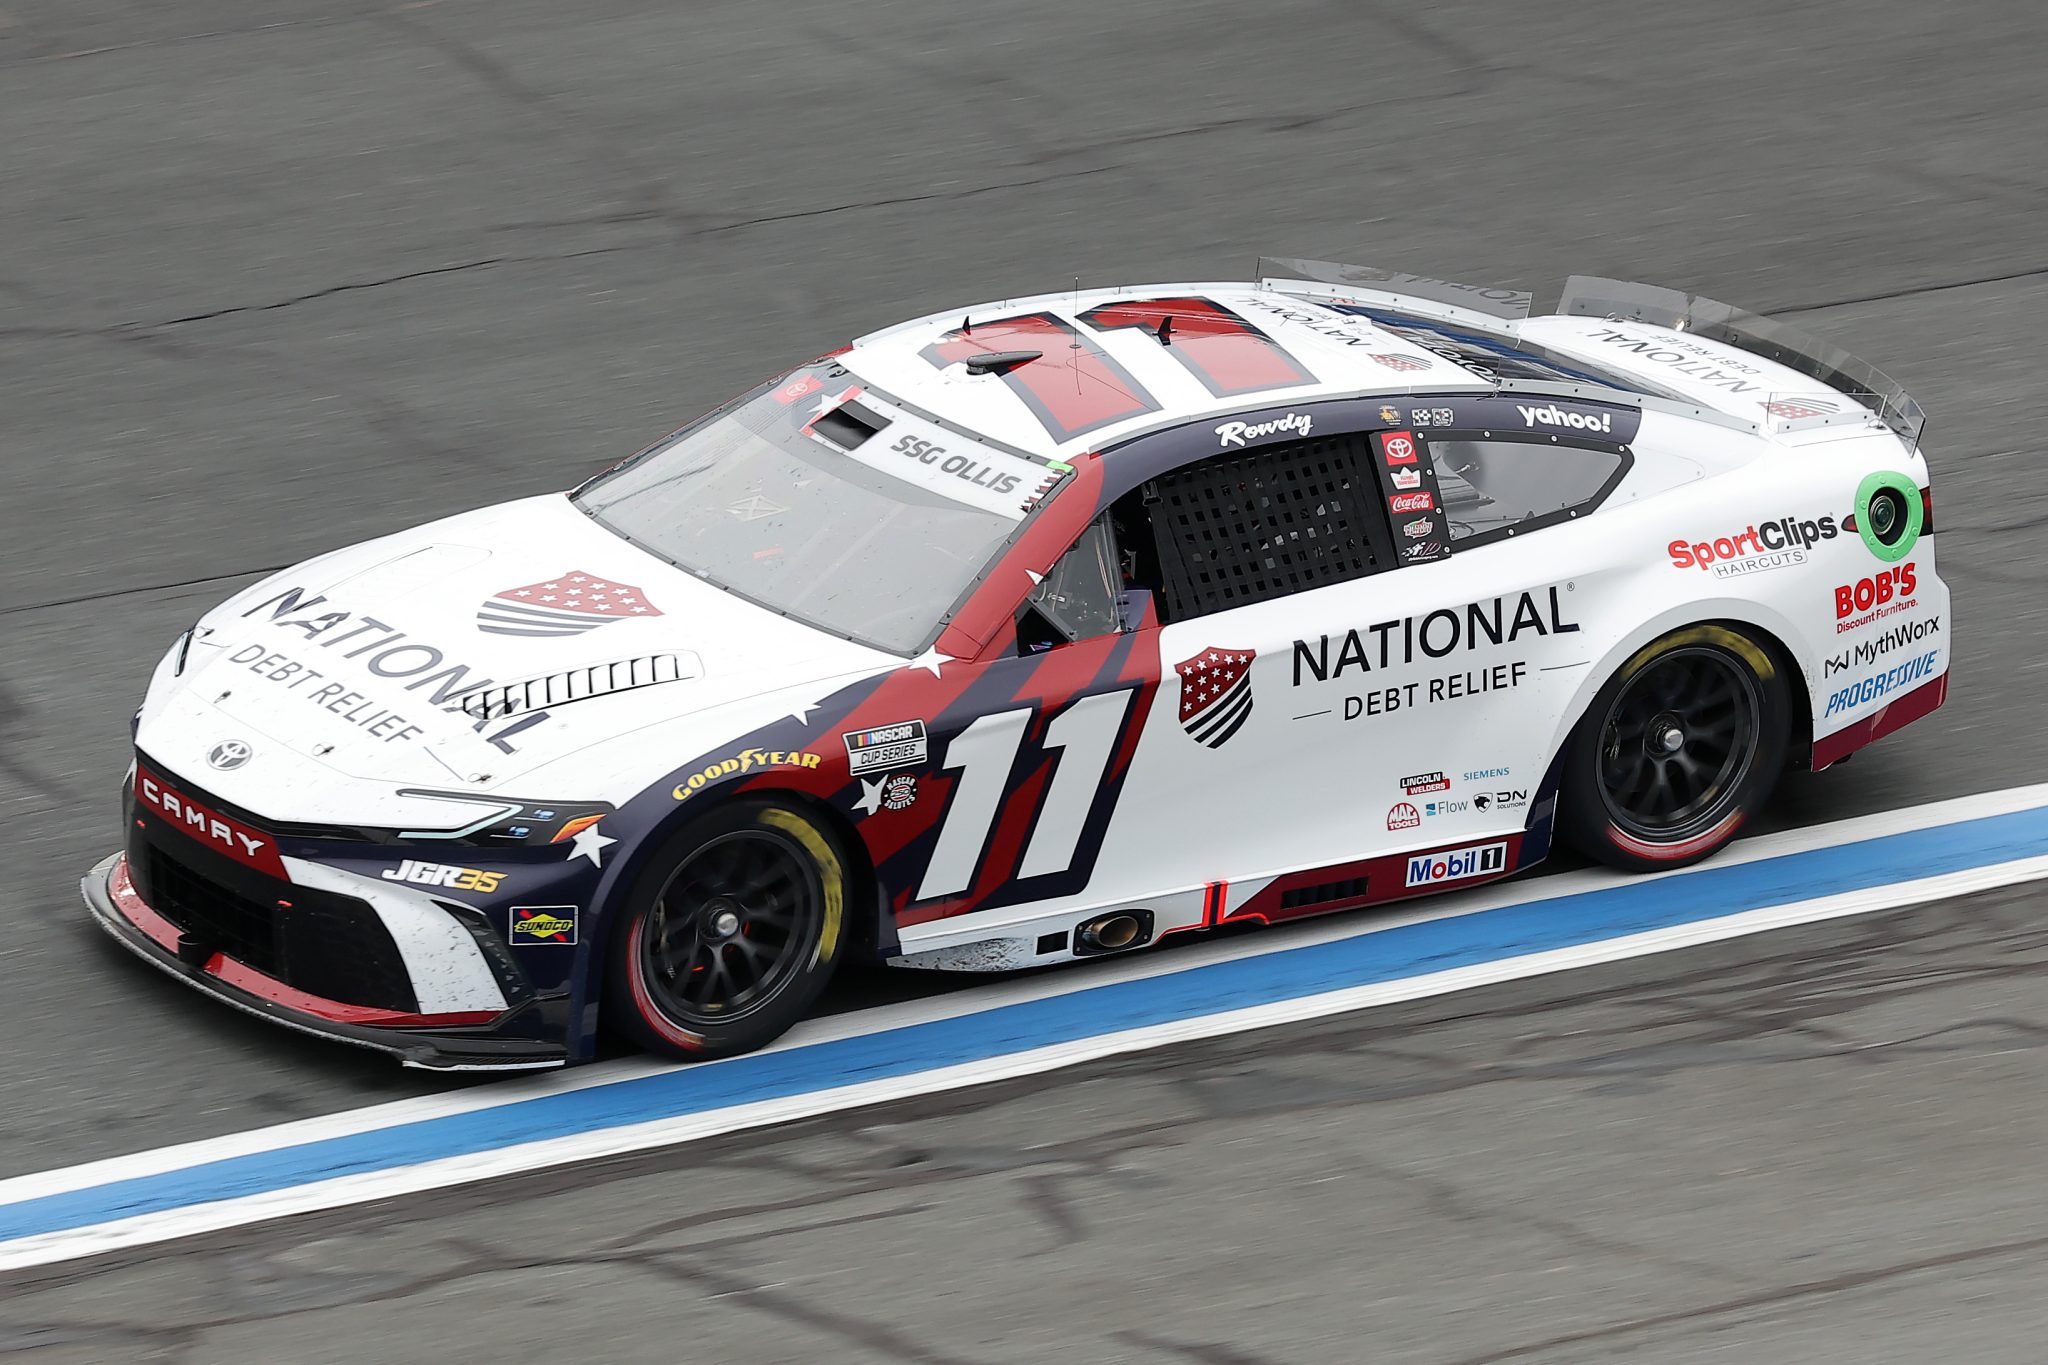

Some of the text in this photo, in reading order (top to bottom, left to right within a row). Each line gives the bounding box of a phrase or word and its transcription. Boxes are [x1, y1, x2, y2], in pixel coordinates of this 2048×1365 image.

[917, 296, 1322, 446] 11
[1587, 328, 1761, 393] NATIONAL
[1648, 334, 1761, 375] DEBT RELIEF
[1214, 412, 1314, 447] Rowdy
[1516, 404, 1611, 433] yahoo!
[890, 434, 1023, 494] SSG OLLIS
[1668, 514, 1838, 571] SportClips
[1716, 550, 1804, 577] HAIRCUTS
[1834, 562, 1917, 620] BOB'S
[1292, 586, 1581, 687] NATIONAL
[1836, 610, 1875, 634] Discount
[1854, 616, 1940, 666] MythWorx
[240, 587, 551, 756] NATIONAL
[1824, 650, 1938, 718] PROGRESSIVE
[229, 643, 425, 746] DEBT RELIEF
[1344, 661, 1527, 721] DEBT RELIEF
[870, 725, 913, 746] NASCAR
[861, 743, 916, 765] CUP SERIES
[672, 747, 822, 801] GOODYEAR
[886, 776, 916, 791] NASCAR
[1402, 772, 1442, 788] LINCOLN
[1410, 782, 1446, 795] WELDERS
[1463, 767, 1510, 781] SIEMENS
[884, 795, 916, 809] SALUTES
[915, 688, 1135, 901] 11
[1438, 800, 1469, 815] Flow
[1496, 789, 1528, 803] DN
[1496, 801, 1527, 810] SOLUTIONS
[143, 778, 265, 856] CAMRY
[1388, 803, 1418, 824] MAC
[1388, 819, 1419, 830] TOOLS
[381, 859, 508, 893] JGR35
[1409, 850, 1477, 884] Mobil
[516, 921, 573, 933] SUNOCO
